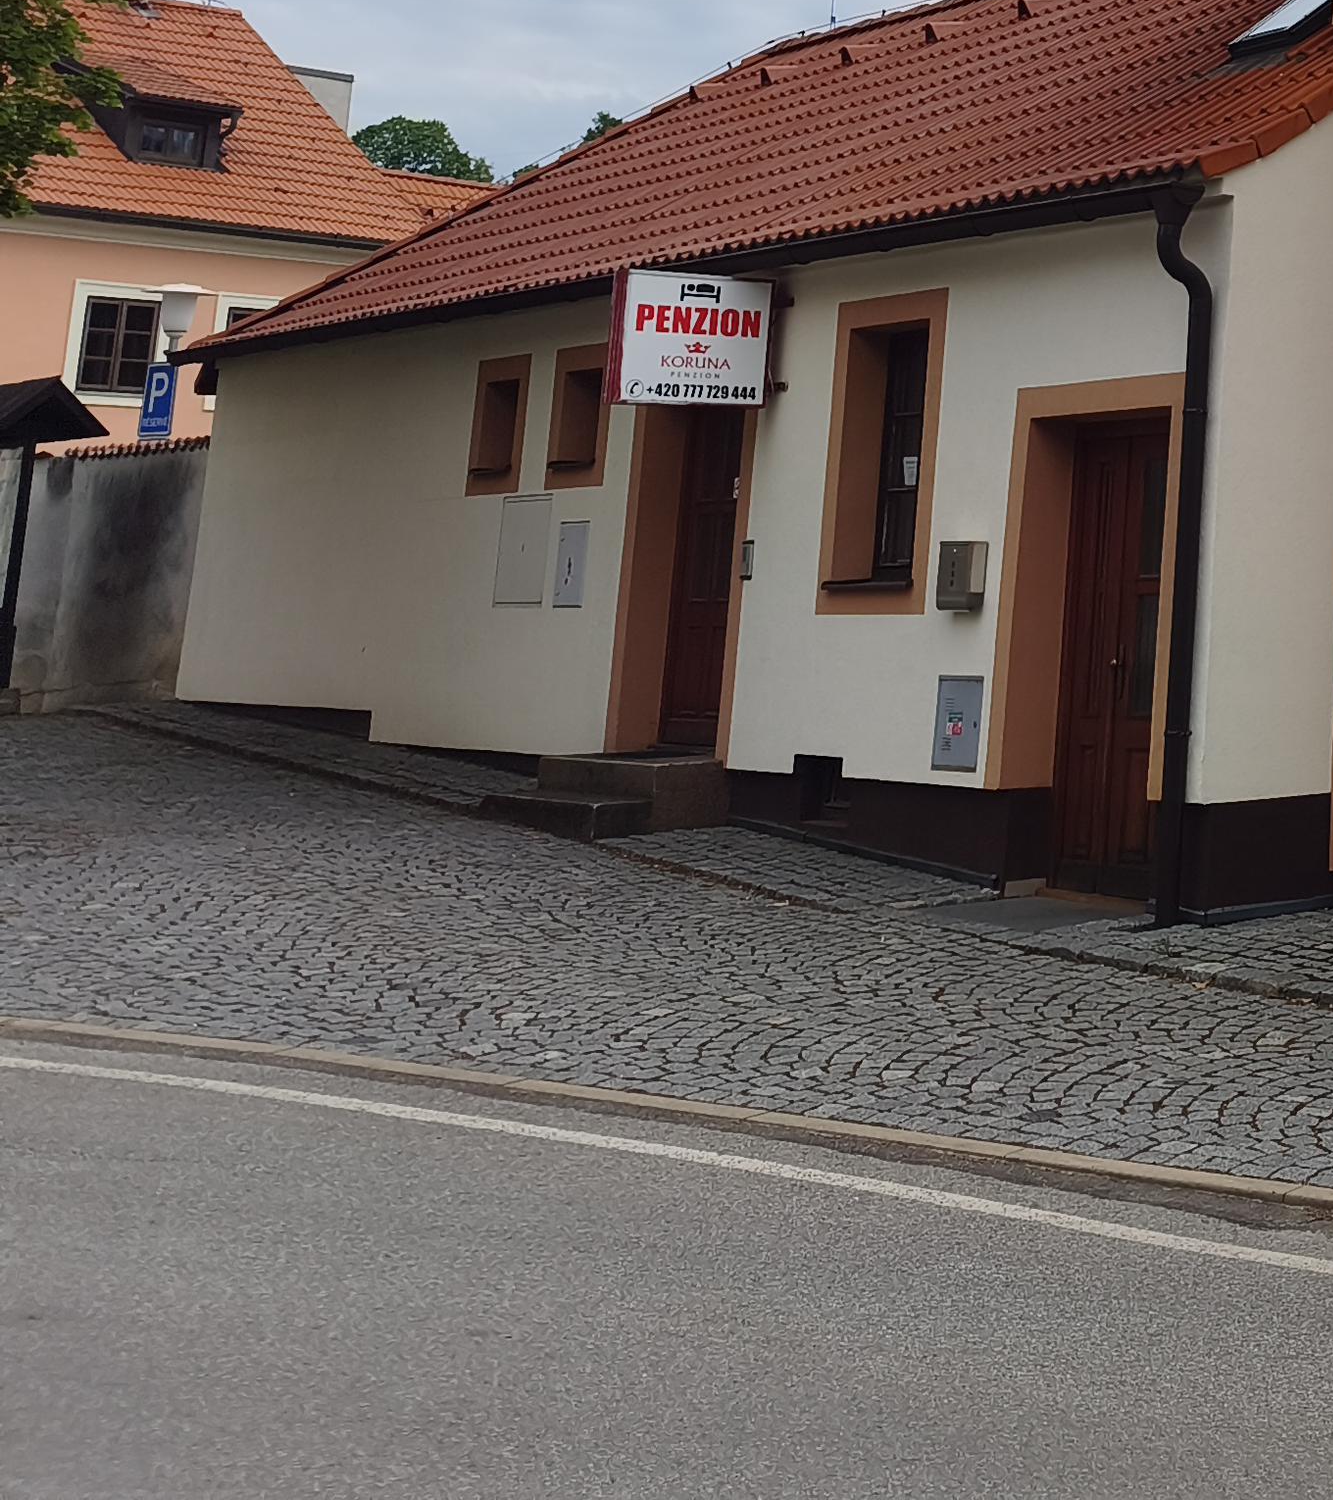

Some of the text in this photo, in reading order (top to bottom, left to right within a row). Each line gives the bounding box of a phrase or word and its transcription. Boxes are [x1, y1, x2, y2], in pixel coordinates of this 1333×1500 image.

[635, 304, 762, 338] PENZION
[660, 355, 731, 371] KORUNA
[148, 372, 169, 413] P
[646, 383, 757, 400] +420 777 729 444
